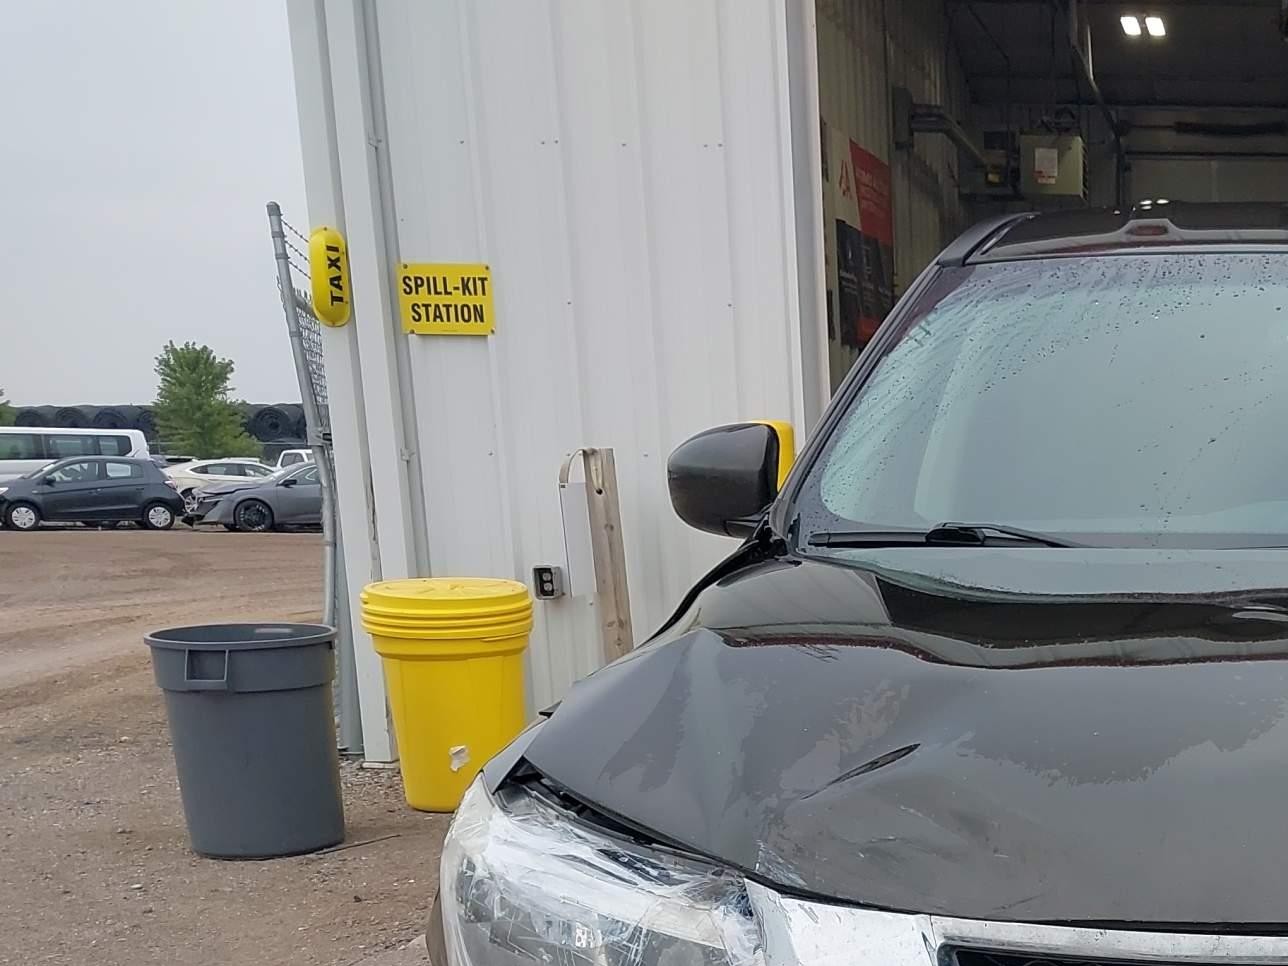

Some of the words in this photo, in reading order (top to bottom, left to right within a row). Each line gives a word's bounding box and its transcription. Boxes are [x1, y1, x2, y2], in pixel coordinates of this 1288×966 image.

[325, 244, 344, 307] TAXI
[402, 275, 489, 296] SPILL-KIT
[411, 302, 485, 323] STATION
